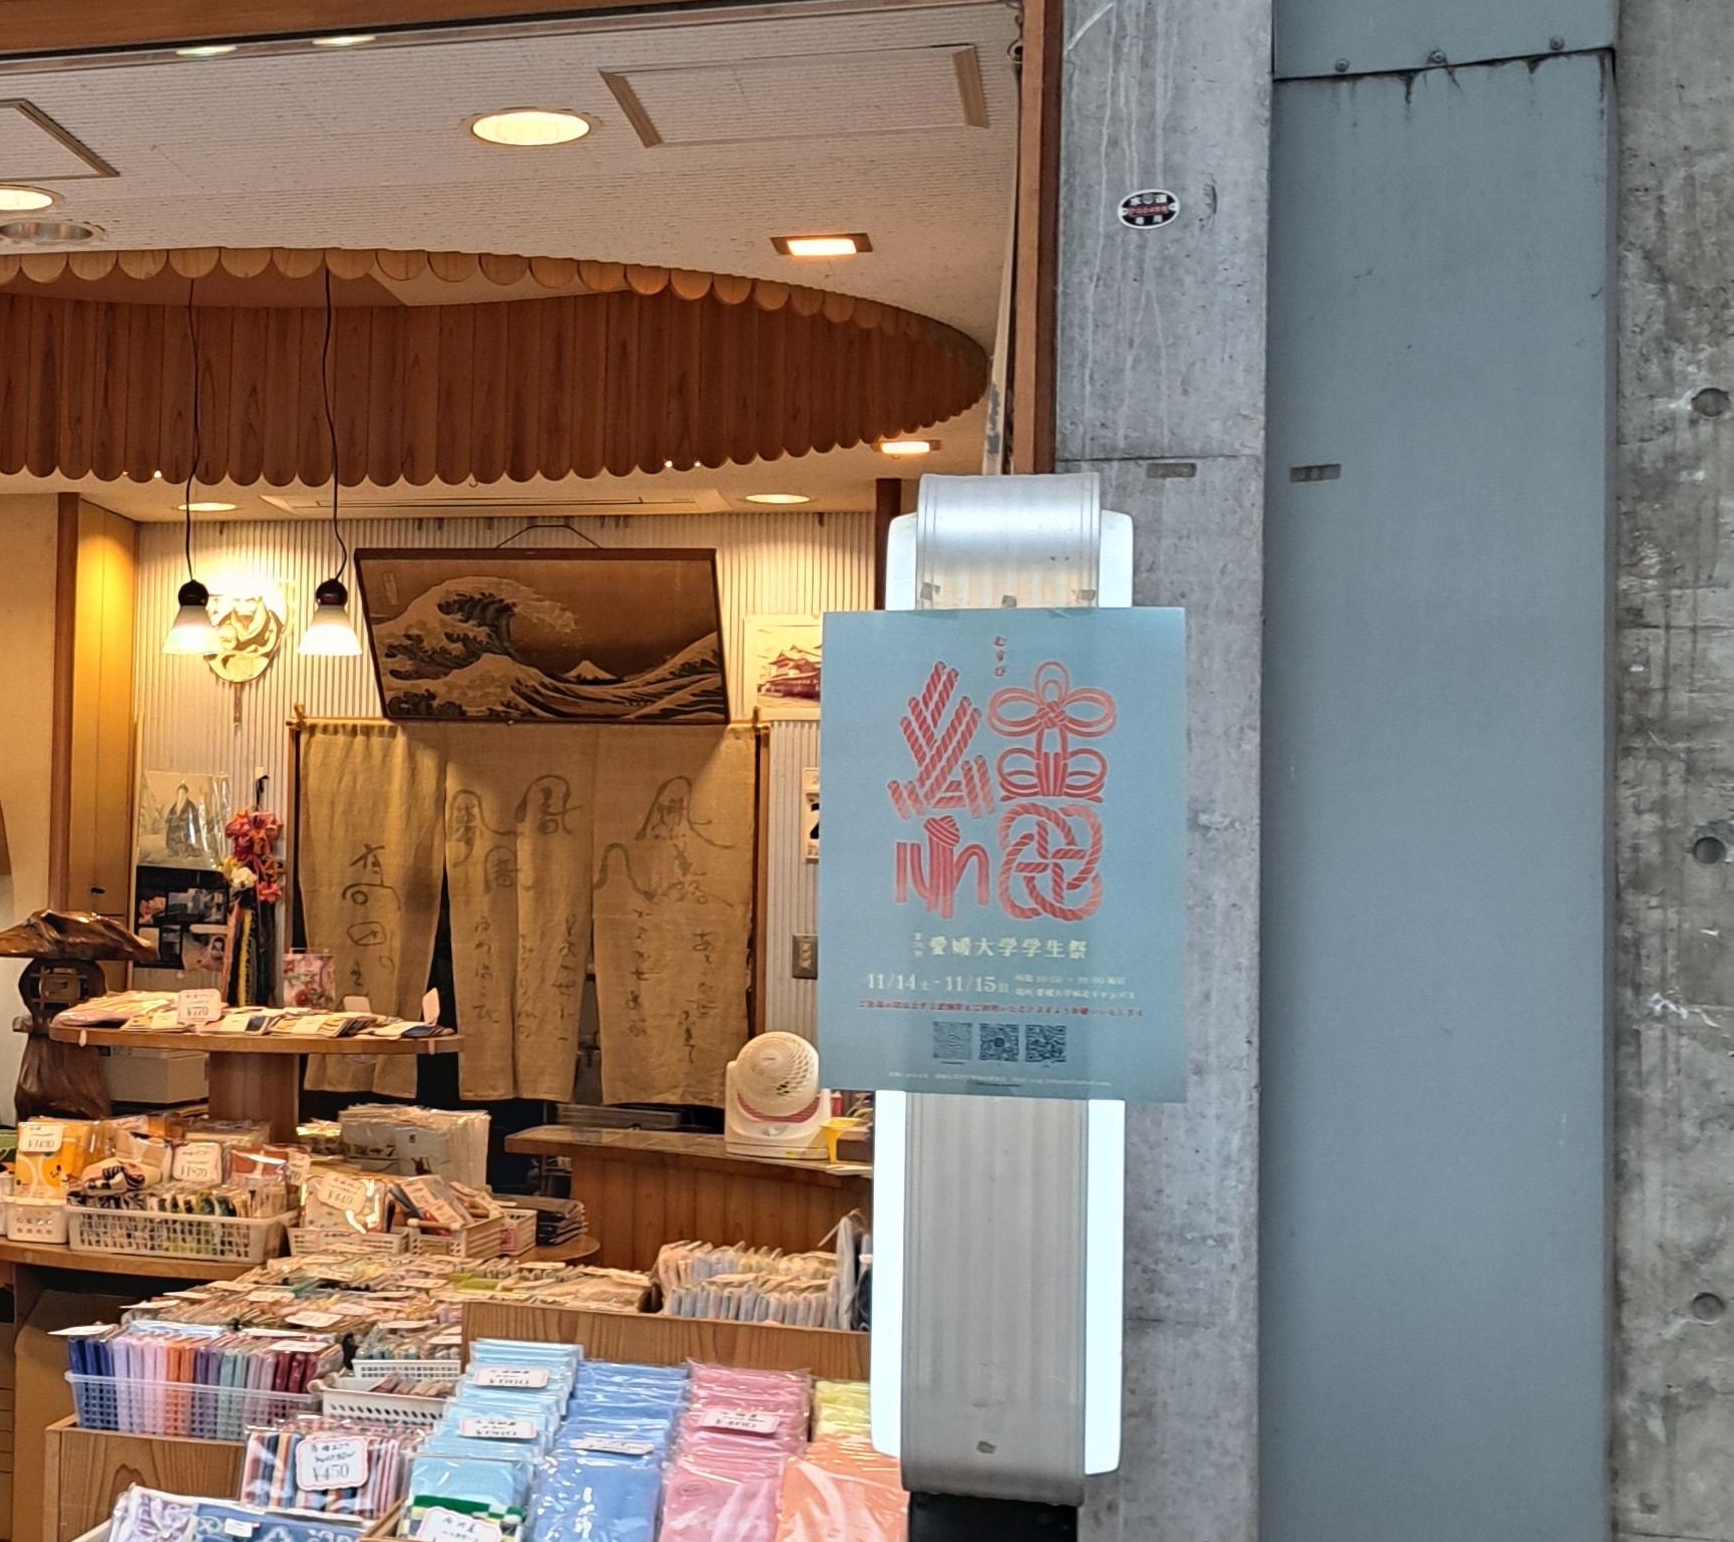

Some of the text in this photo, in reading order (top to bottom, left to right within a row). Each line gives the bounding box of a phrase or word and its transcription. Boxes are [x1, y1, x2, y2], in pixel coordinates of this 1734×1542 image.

[929, 935, 1088, 960] 愛媛大学学生祭
